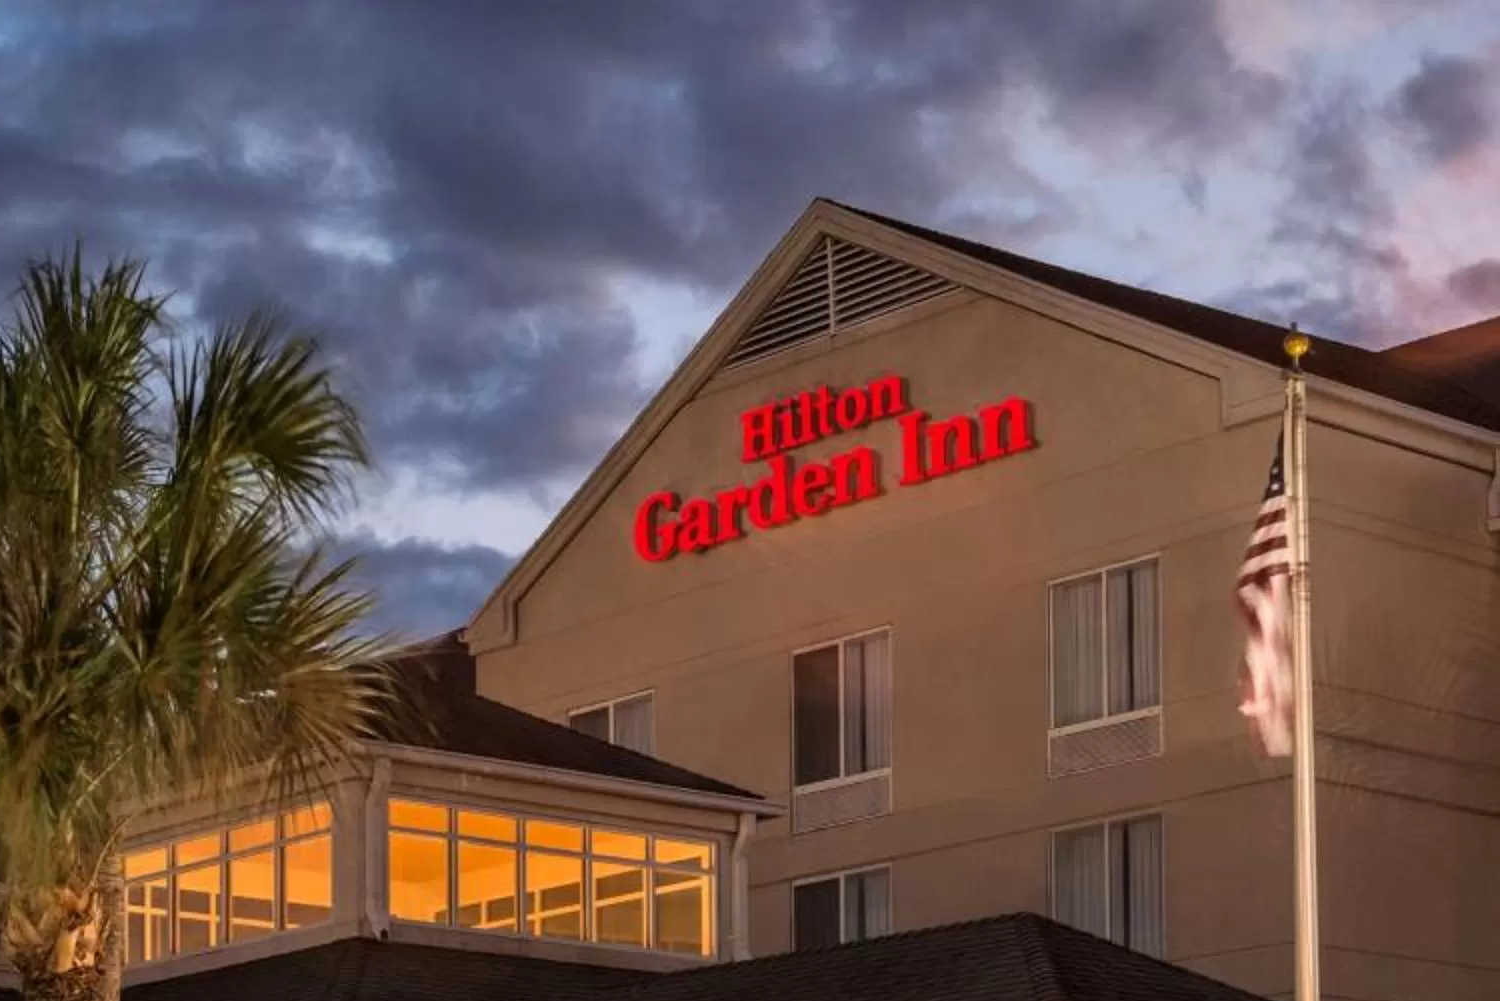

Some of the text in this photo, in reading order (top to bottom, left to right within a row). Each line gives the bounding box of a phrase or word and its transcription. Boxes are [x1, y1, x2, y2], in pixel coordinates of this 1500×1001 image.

[632, 394, 1035, 563] Garden Inn
[740, 374, 907, 463] Hilton
